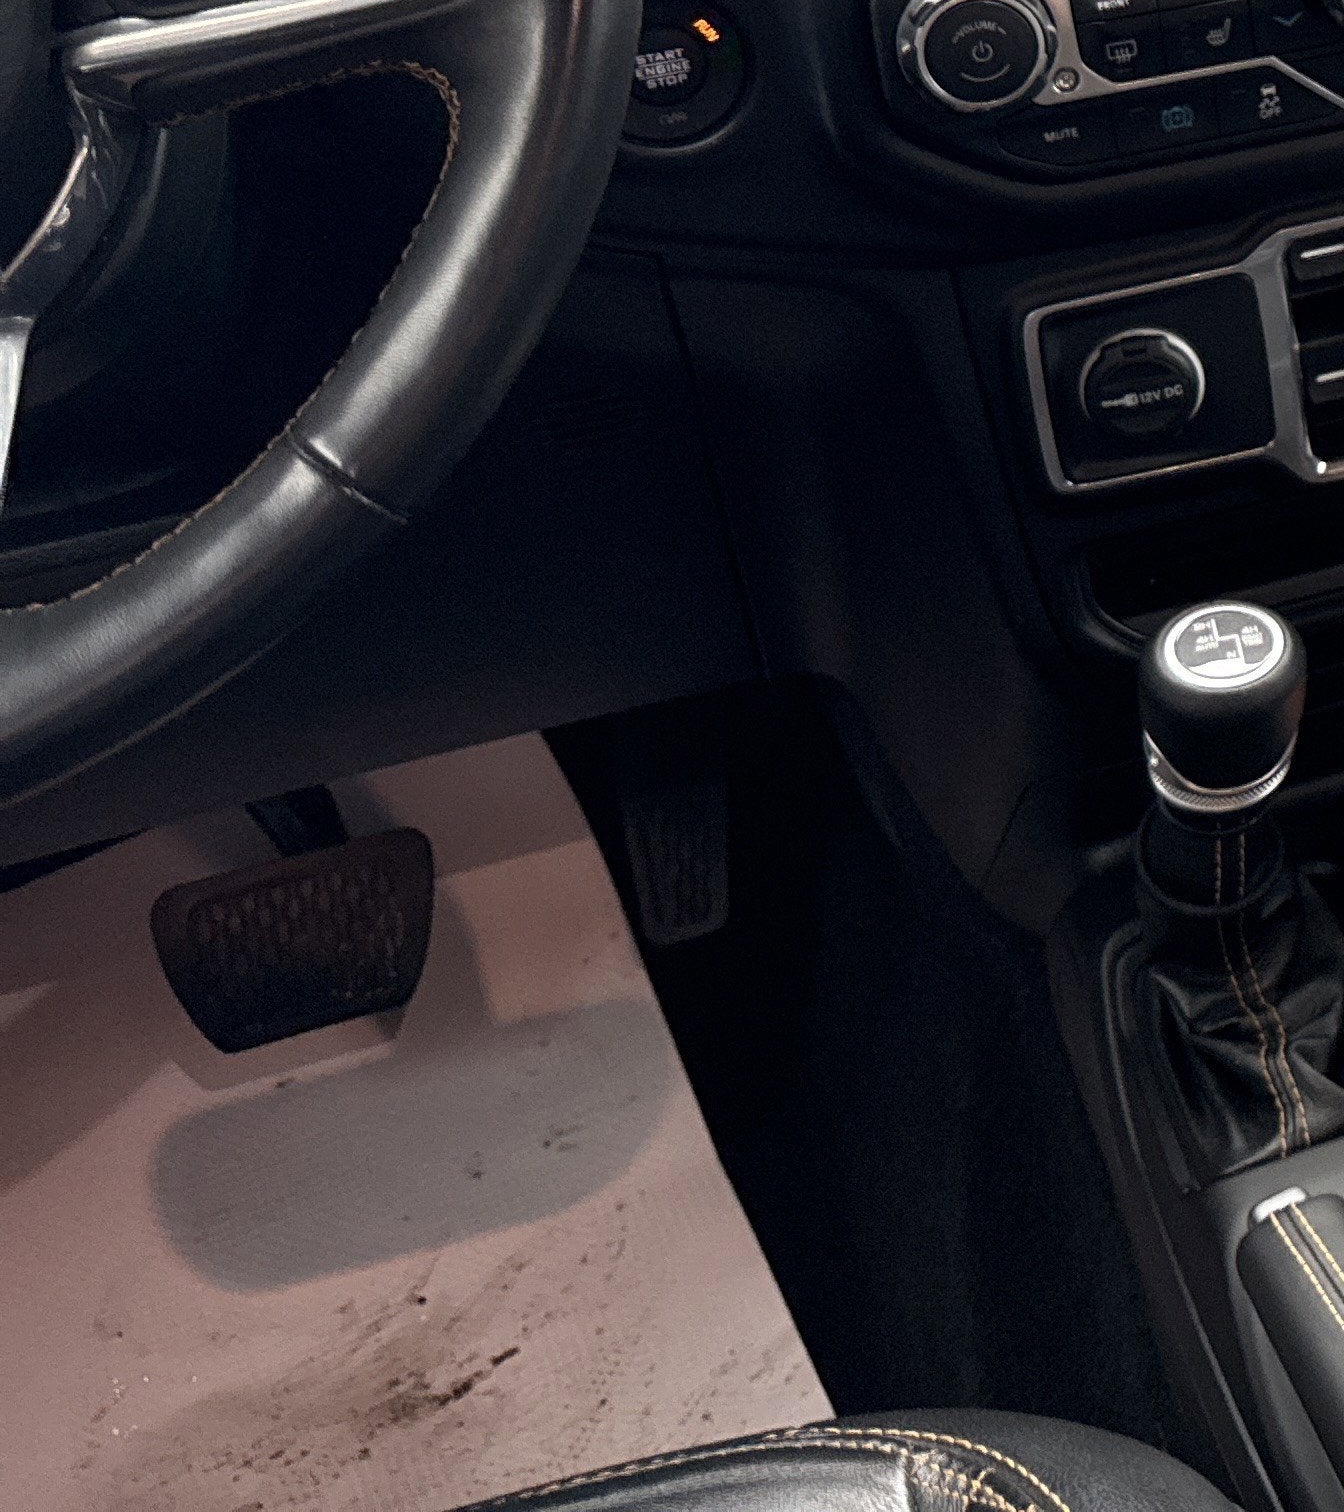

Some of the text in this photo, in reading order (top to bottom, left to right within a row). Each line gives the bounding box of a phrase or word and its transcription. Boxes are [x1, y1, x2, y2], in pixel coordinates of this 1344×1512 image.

[636, 48, 684, 65] START
[635, 58, 691, 81] ENGINE
[646, 73, 688, 89] STOP
[1044, 127, 1080, 142] MUTE
